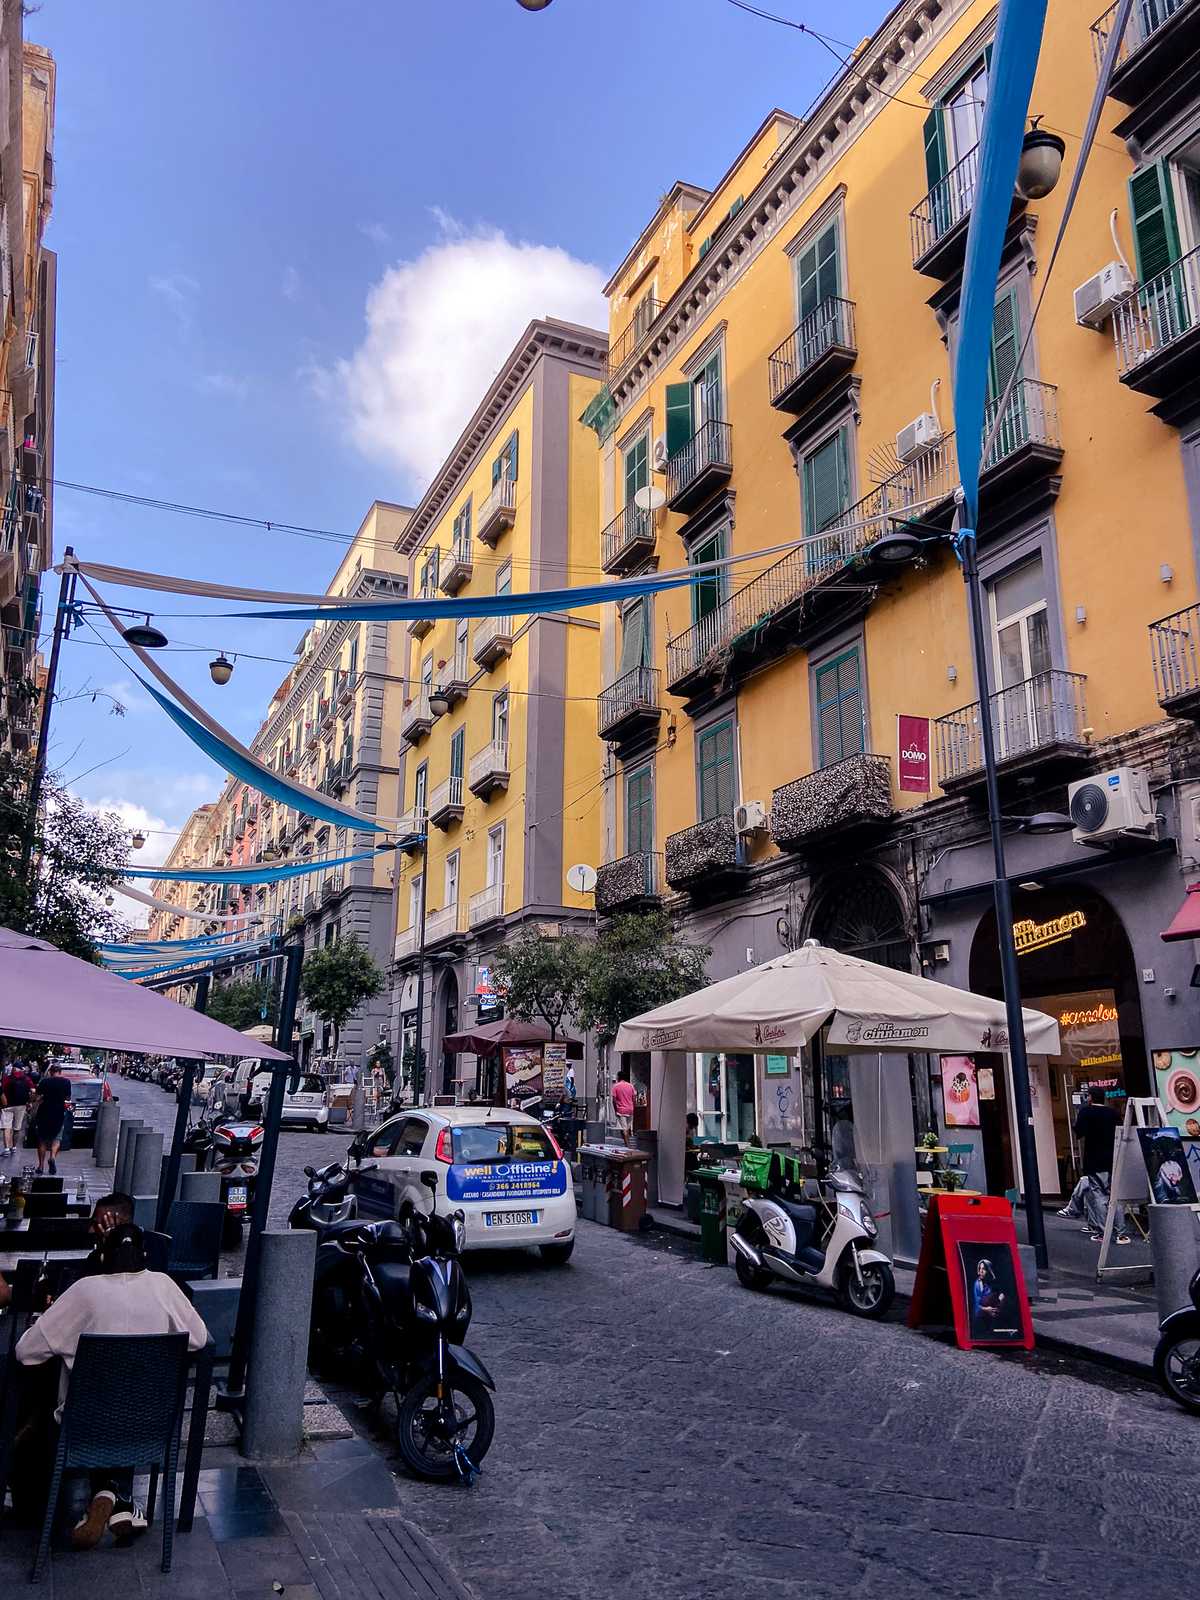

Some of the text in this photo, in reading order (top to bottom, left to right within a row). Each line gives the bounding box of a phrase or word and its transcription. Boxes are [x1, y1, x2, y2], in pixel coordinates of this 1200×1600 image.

[902, 750, 926, 761] DOMO
[1014, 911, 1085, 949] nnamon
[463, 1165, 491, 1176] well
[492, 1215, 503, 1225] EN
